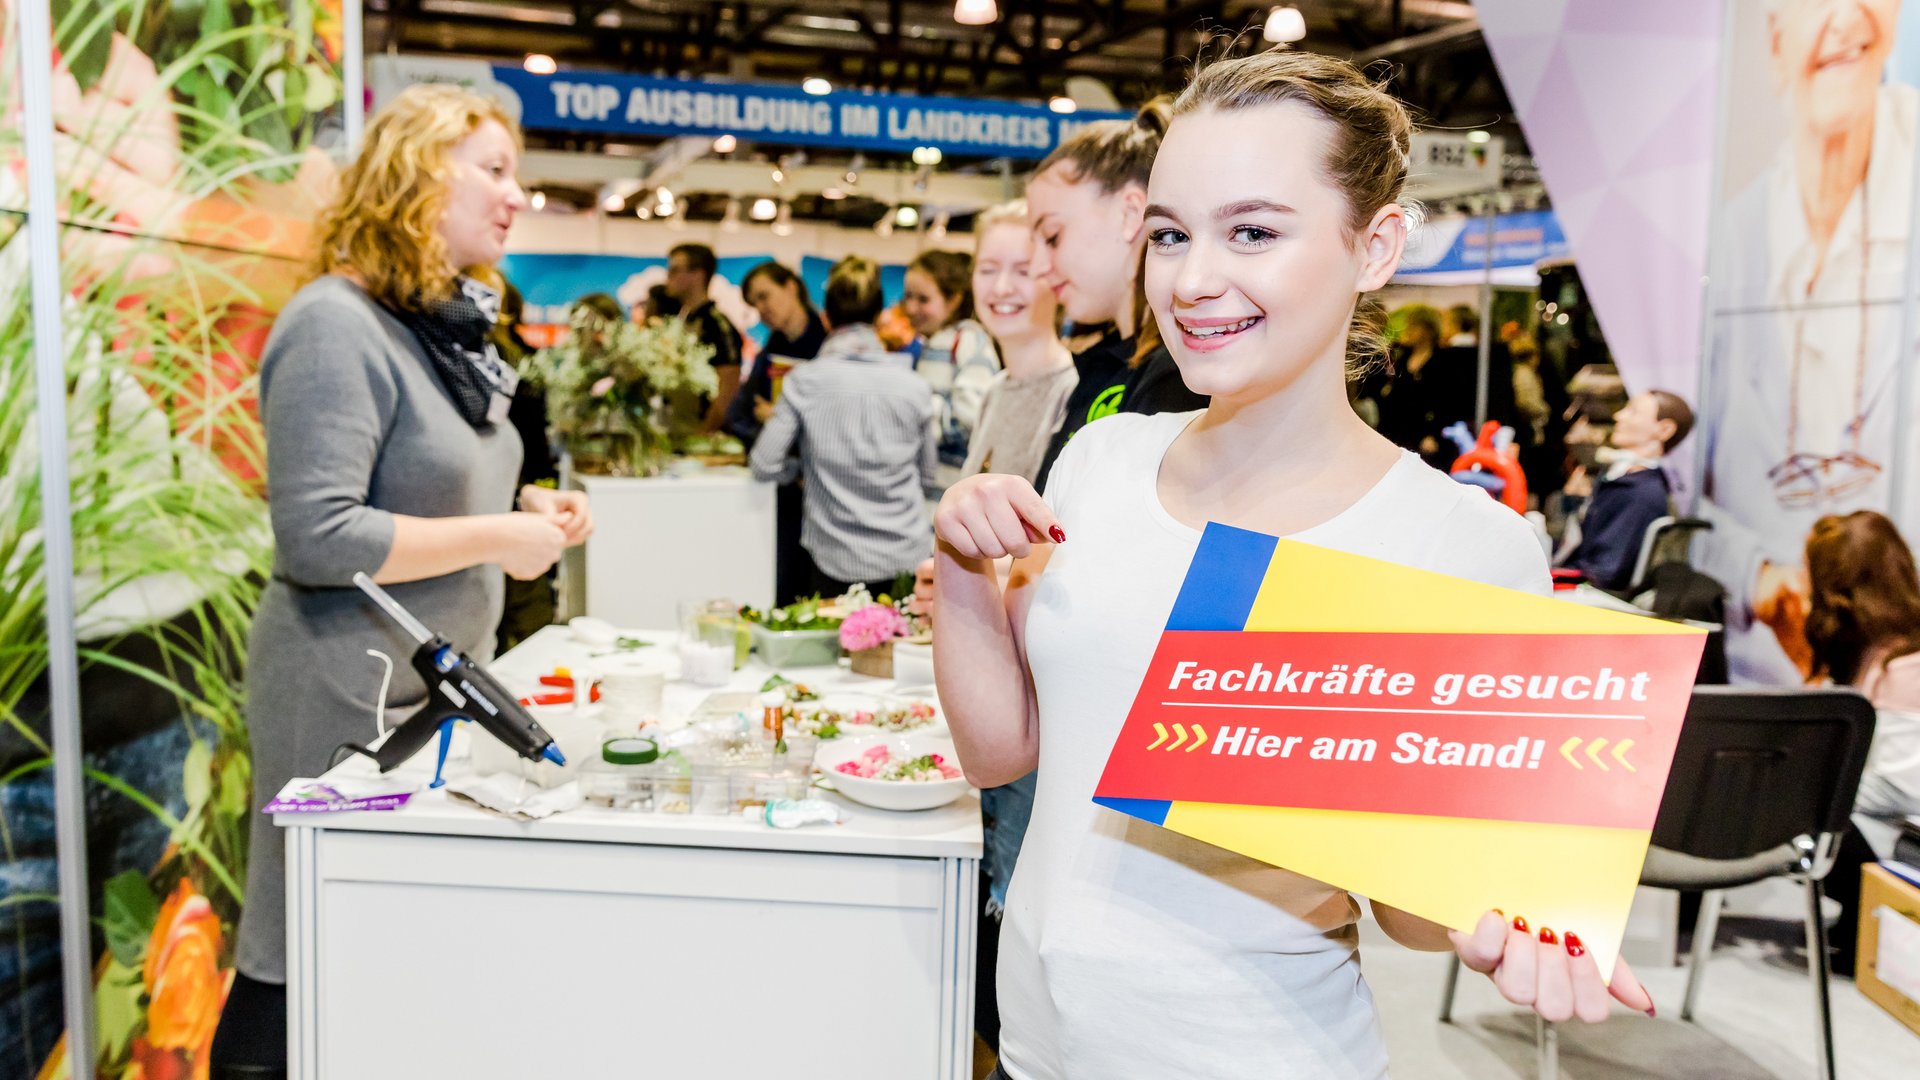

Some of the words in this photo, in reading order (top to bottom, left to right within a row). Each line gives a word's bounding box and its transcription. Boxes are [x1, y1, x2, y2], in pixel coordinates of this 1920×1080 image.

[551, 82, 619, 119] TOP
[626, 88, 832, 135] AUSBILDUNG
[840, 105, 879, 136] IM
[887, 109, 1050, 148] LANDKREIS
[1167, 660, 1416, 697] Fachkräfte
[1430, 666, 1652, 705] gesucht
[1210, 725, 1304, 758] Hier
[1308, 736, 1378, 762] am
[1390, 731, 1547, 770] Stand!
